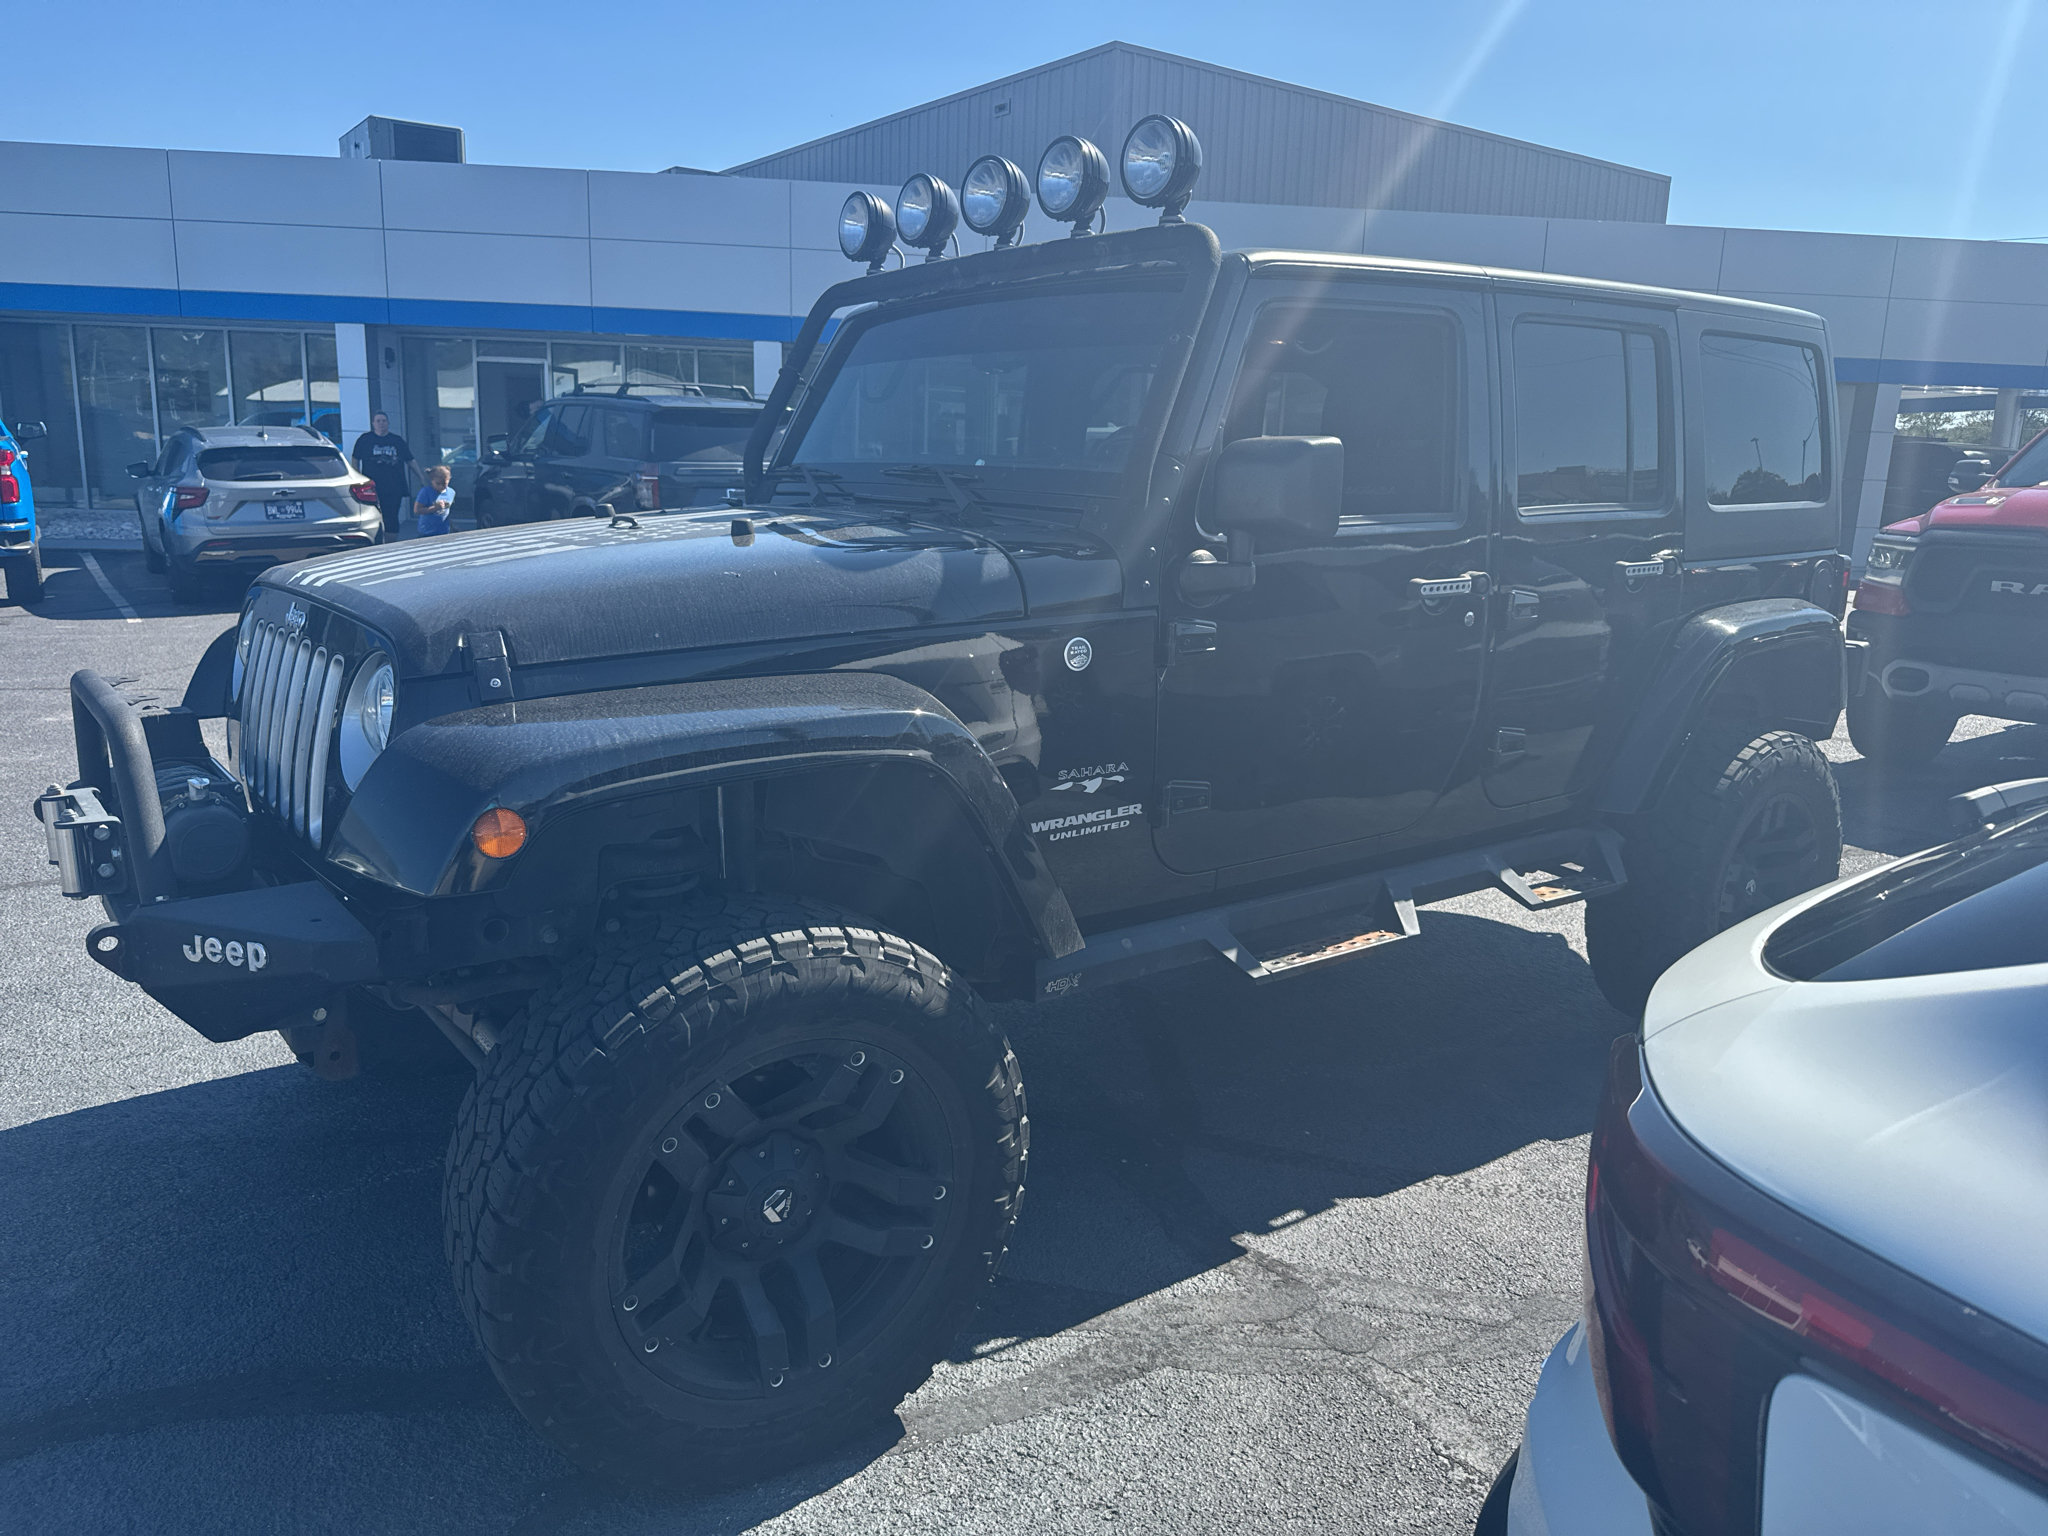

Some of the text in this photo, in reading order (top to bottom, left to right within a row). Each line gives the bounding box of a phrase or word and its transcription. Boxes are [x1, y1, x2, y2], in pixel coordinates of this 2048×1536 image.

[1058, 761, 1129, 781] SAHARA
[1030, 803, 1143, 833] WRANGLER
[1049, 820, 1130, 841] UNLIMITED
[182, 934, 268, 972] Jeep
[783, 1191, 793, 1218] FUEL
